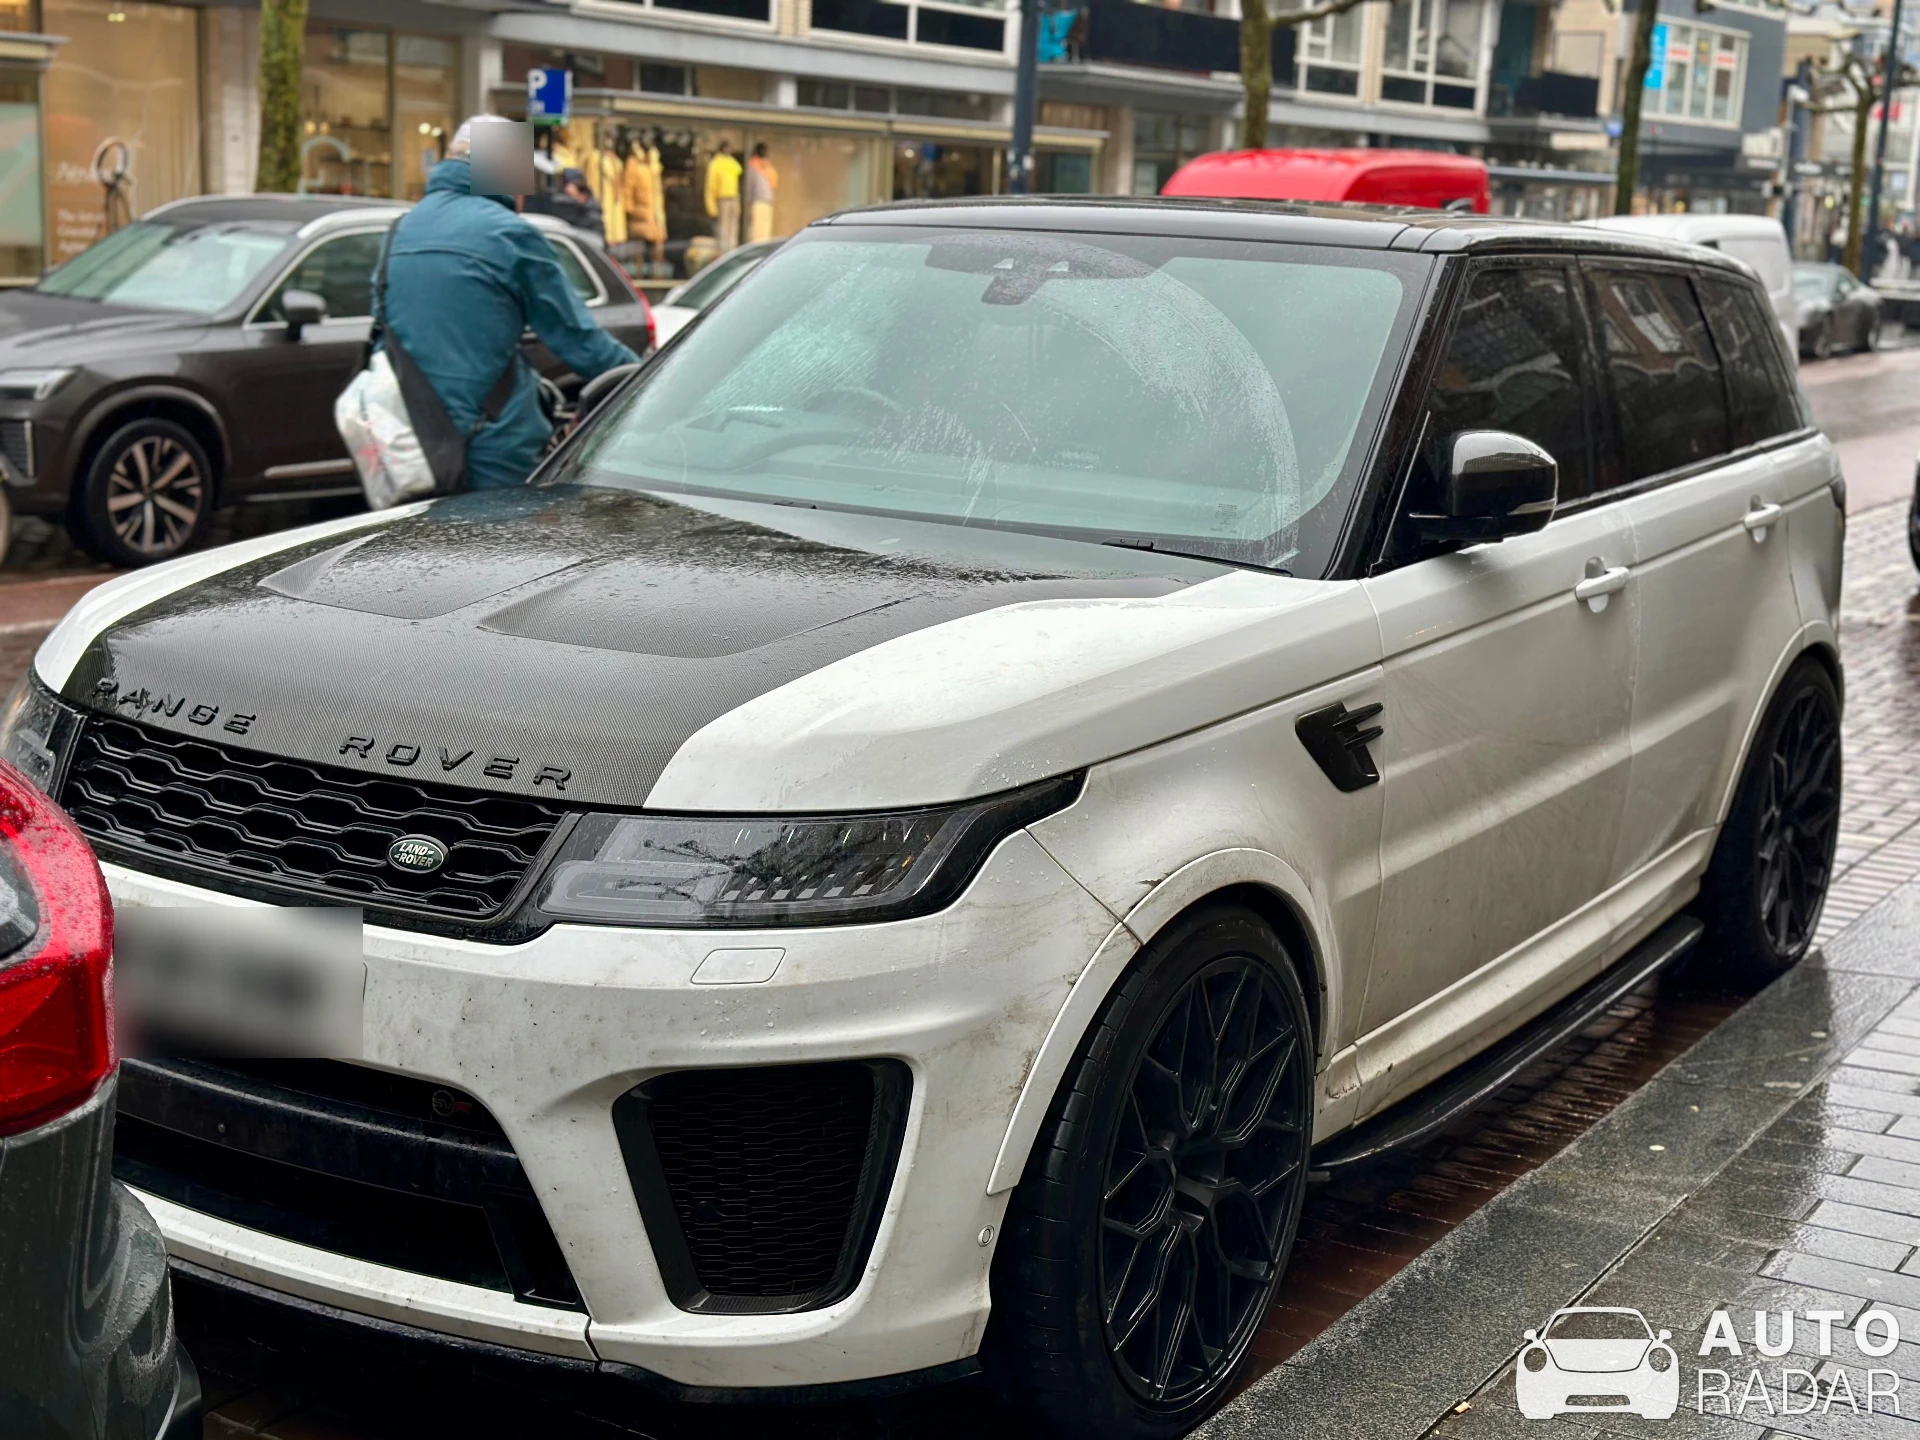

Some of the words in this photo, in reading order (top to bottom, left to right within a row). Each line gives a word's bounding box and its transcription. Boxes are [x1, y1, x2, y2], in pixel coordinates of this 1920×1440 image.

[528, 68, 548, 99] P
[92, 677, 257, 735] RANGE
[339, 733, 572, 790] ROVER
[398, 843, 429, 855] LAND
[398, 853, 434, 867] ROVER
